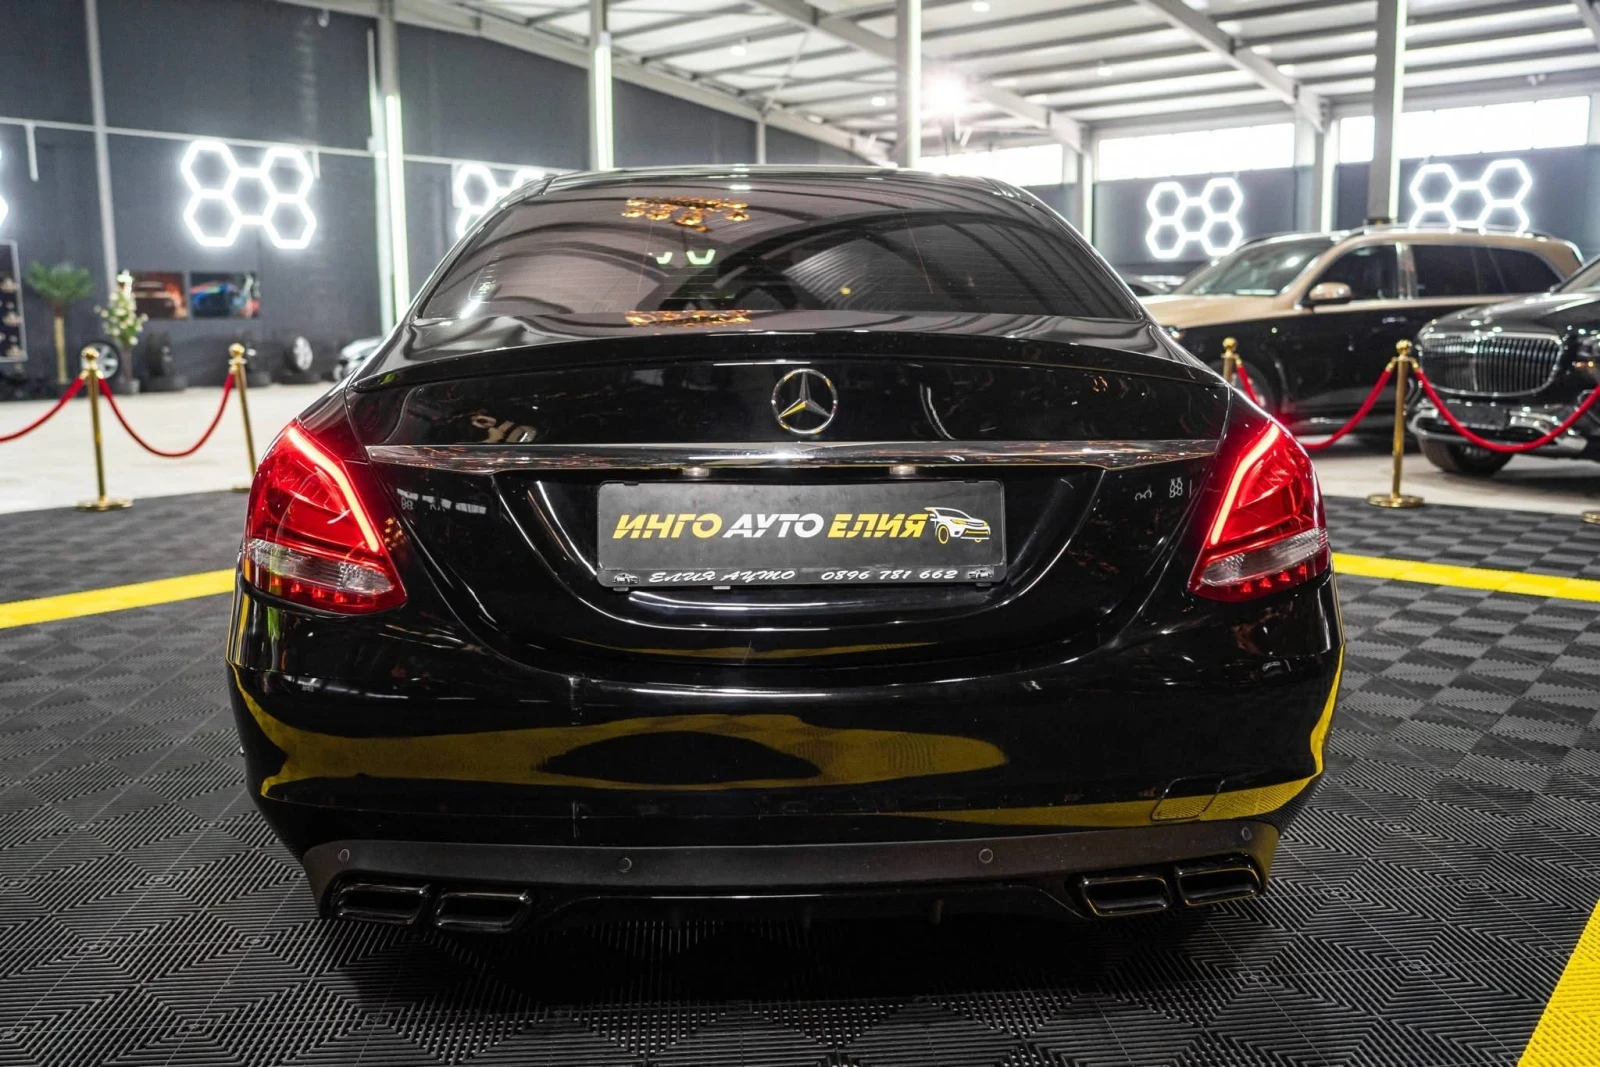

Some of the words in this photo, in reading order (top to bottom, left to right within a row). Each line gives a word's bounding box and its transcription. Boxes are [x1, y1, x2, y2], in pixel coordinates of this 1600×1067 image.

[612, 513, 722, 539] ИНГО
[723, 513, 824, 539] АУТО
[827, 513, 930, 539] ЕЛИЯ
[821, 570, 870, 581] 0896
[879, 570, 912, 580] 781
[919, 570, 958, 580] 662
